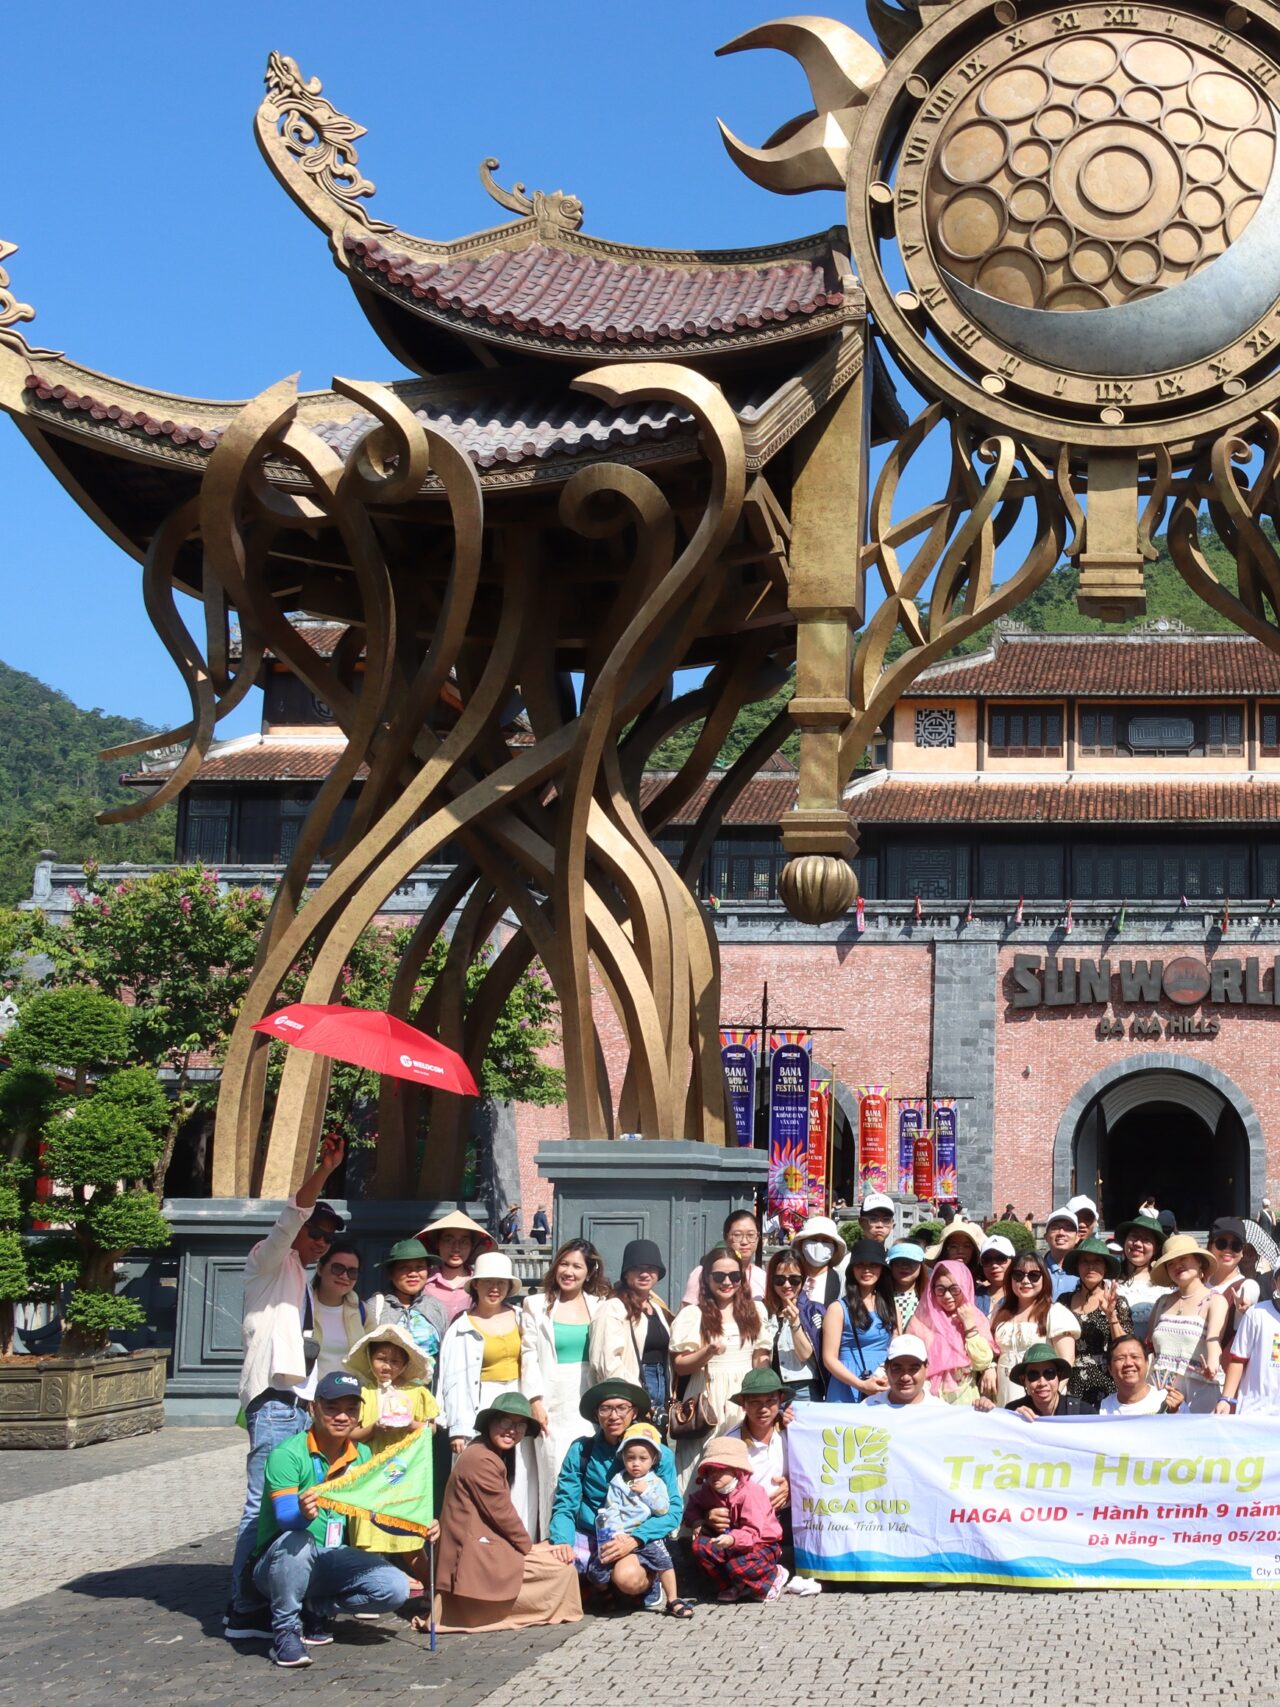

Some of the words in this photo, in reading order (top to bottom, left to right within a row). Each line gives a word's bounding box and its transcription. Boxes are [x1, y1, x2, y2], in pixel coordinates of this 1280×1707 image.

[1013, 954, 1111, 1008] SUN
[1170, 1015, 1221, 1034] HILLS
[944, 1449, 1071, 1490] Trầm
[1091, 1453, 1265, 1493] Hương
[802, 1497, 859, 1514] HAGA
[865, 1499, 911, 1514] OUD
[950, 1507, 1012, 1523] HAGA
[1020, 1506, 1068, 1522] OUD
[1092, 1504, 1149, 1521] Hành
[1156, 1503, 1208, 1520] trình
[1216, 1503, 1229, 1518] 9
[1088, 1533, 1110, 1546] Đà
[1172, 1531, 1222, 1545] Tháng
